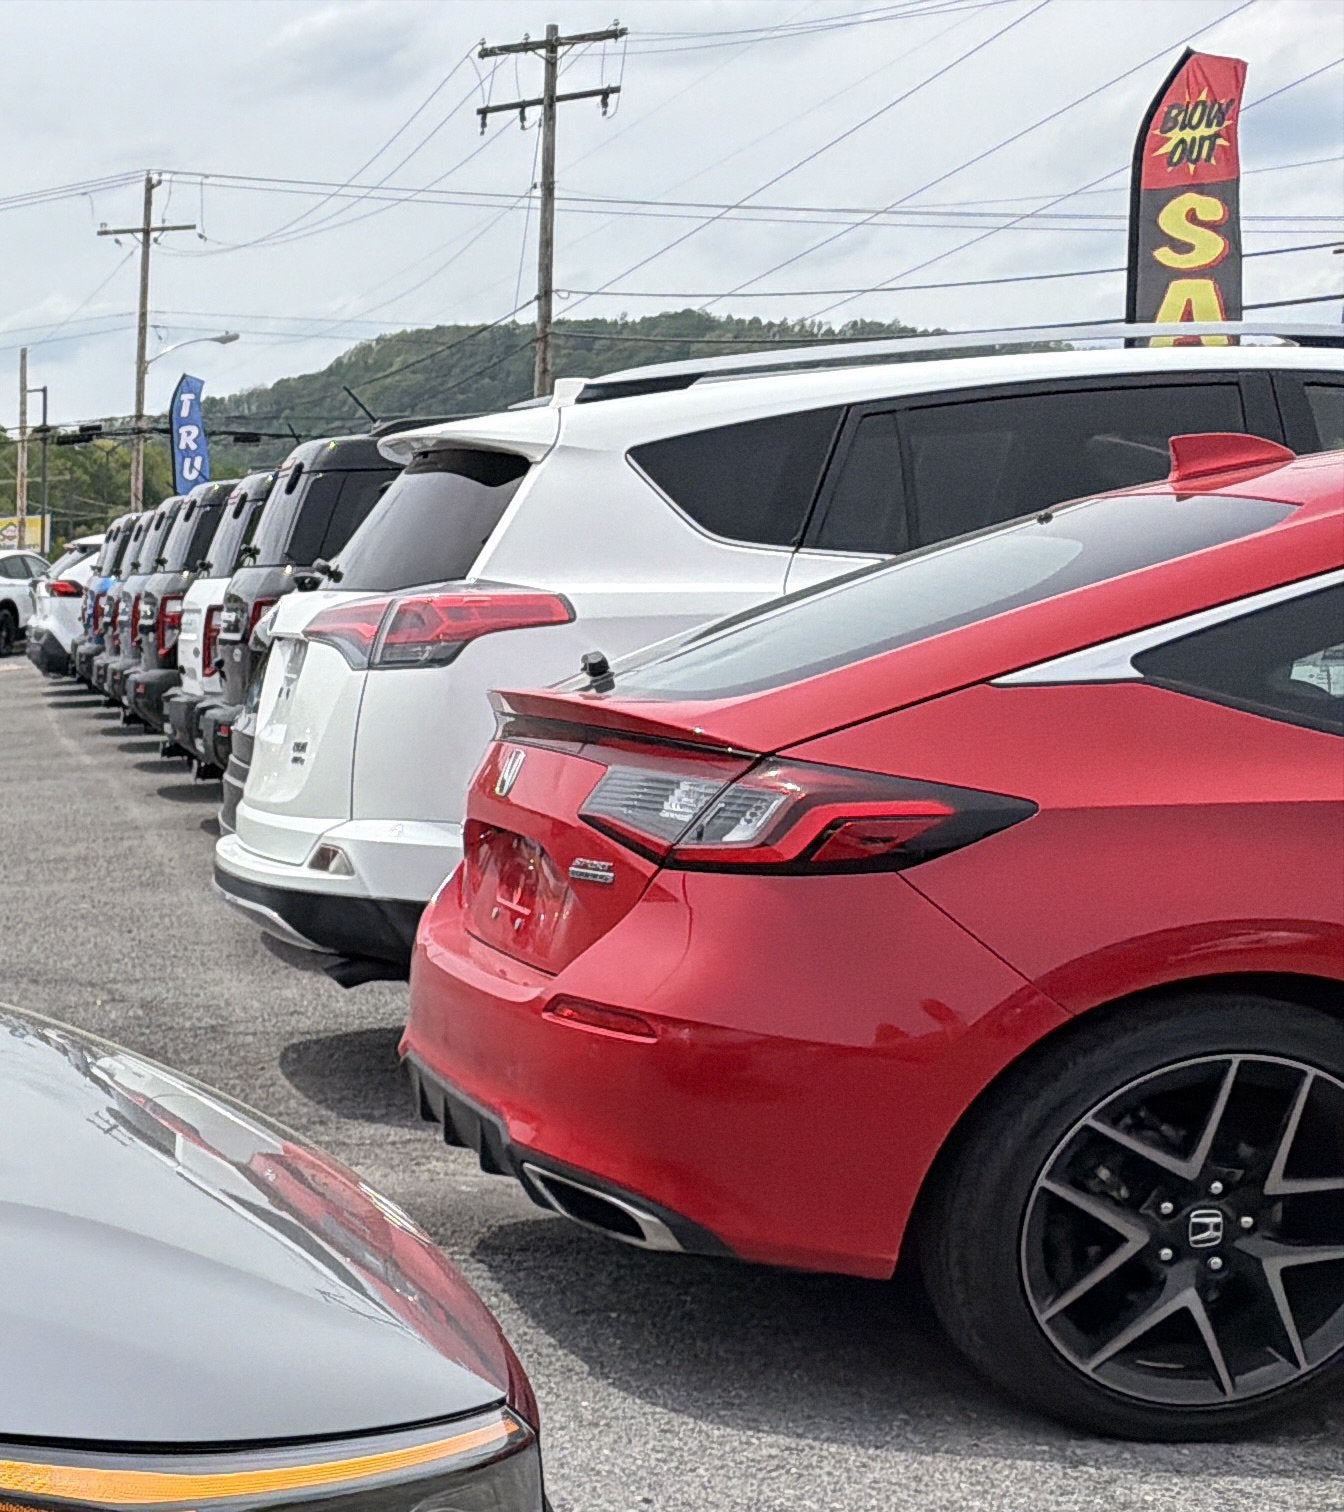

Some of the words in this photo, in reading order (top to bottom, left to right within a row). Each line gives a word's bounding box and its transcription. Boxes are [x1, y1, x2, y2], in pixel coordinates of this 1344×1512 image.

[1160, 99, 1235, 132] BLOW
[1168, 133, 1221, 167] OUT
[178, 393, 202, 481] TRU
